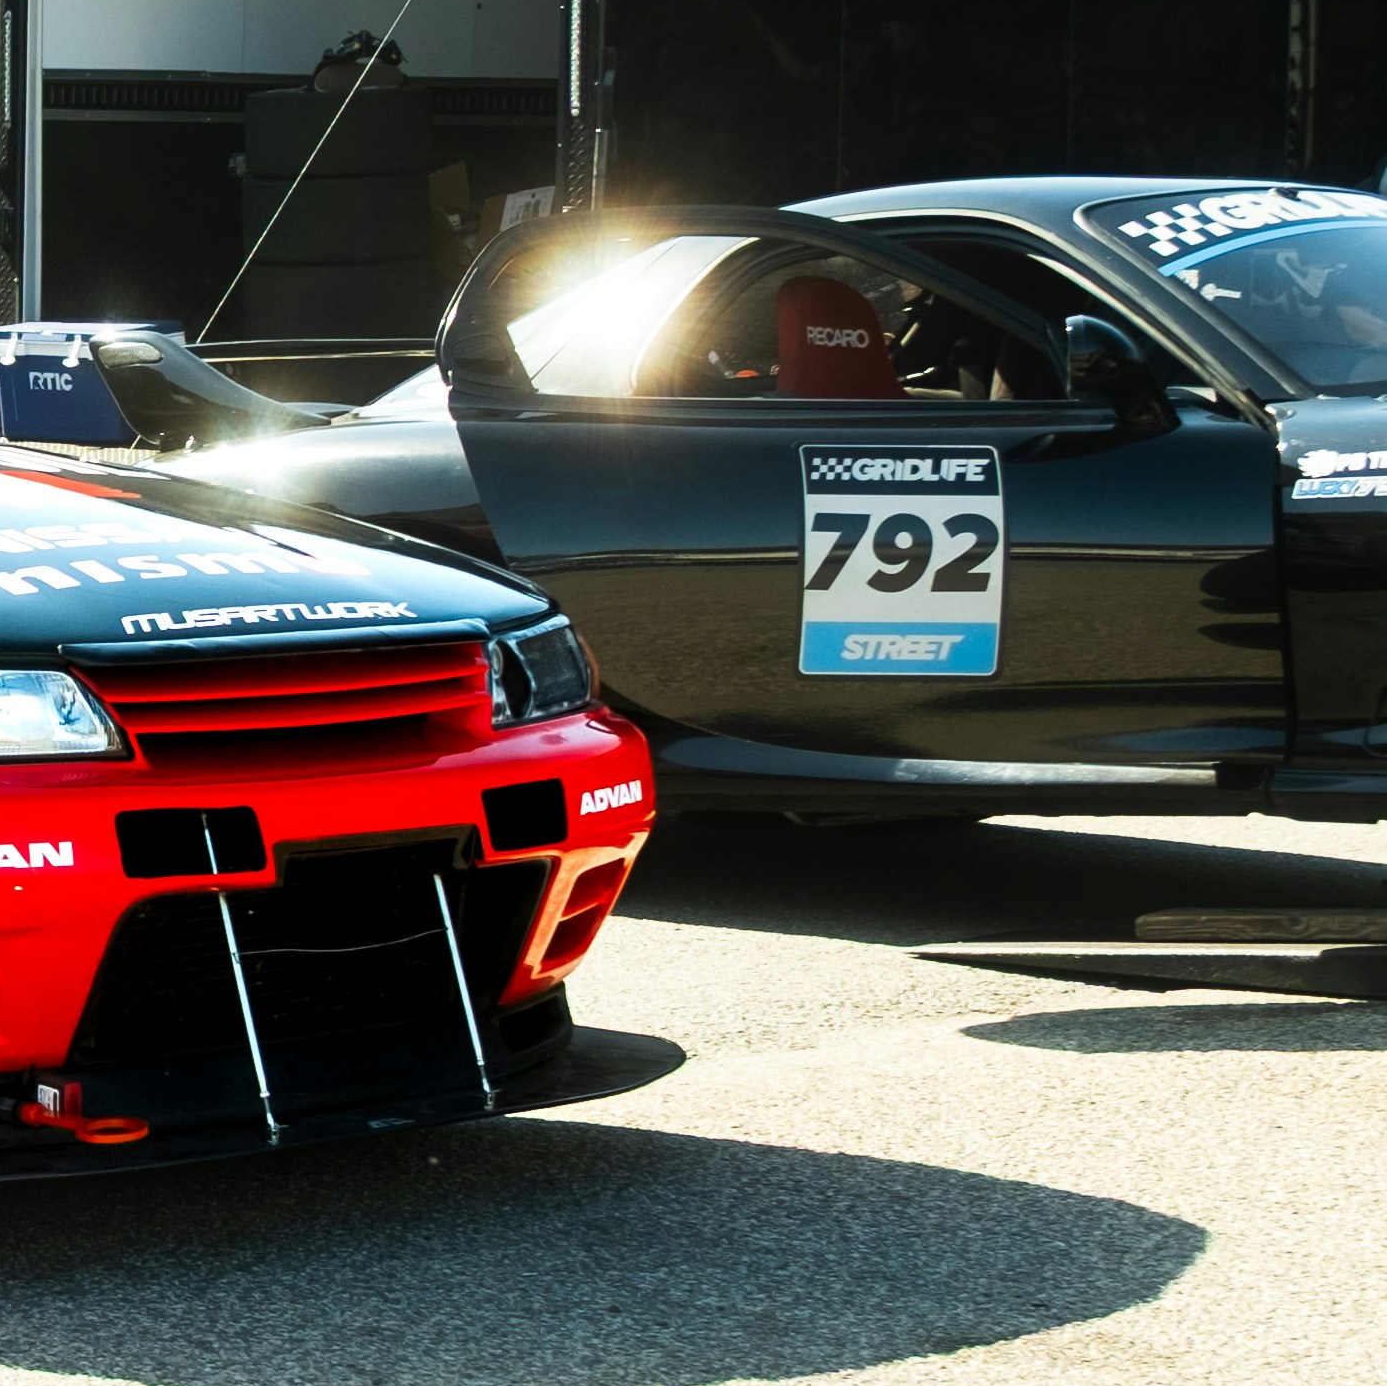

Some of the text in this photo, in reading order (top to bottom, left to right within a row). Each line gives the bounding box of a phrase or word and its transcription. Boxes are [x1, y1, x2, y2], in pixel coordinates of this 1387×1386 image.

[805, 325, 870, 351] RECARO
[28, 371, 74, 392] RTIC
[851, 457, 991, 482] GRIDLIFE
[804, 512, 1000, 593] 792
[840, 633, 965, 661] STREET
[580, 779, 643, 817] ADVAN
